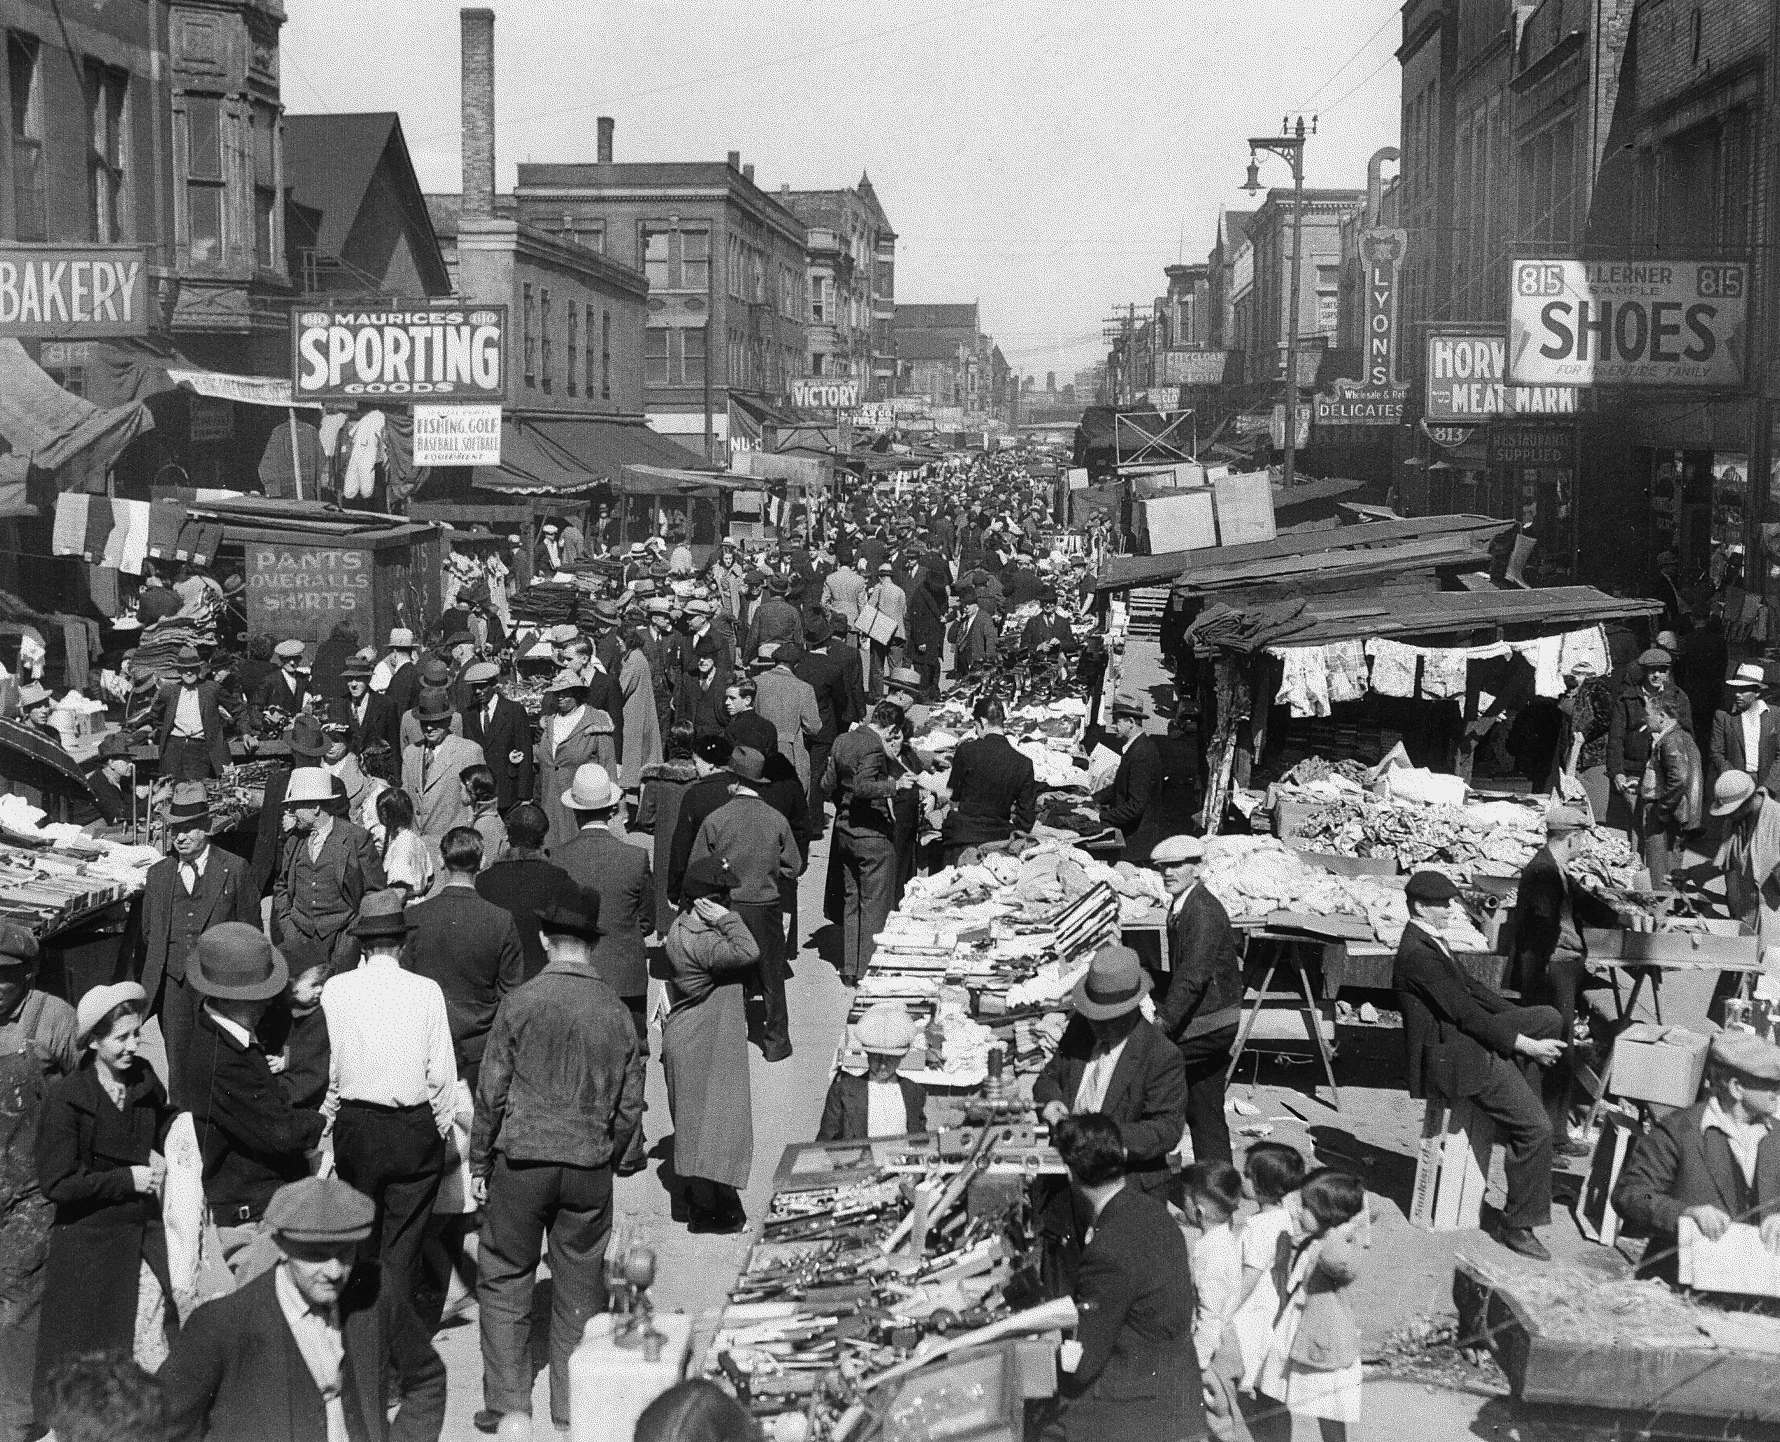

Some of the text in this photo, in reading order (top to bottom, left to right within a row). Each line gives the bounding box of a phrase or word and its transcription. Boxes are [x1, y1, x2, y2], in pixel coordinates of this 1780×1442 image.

[1521, 266, 1561, 294] 815
[1596, 267, 1672, 284] LERNER
[1700, 269, 1740, 296] 815
[1589, 285, 1661, 296] SAMPLE
[0, 261, 139, 322] BAKERY
[1540, 301, 1718, 362] SHOES
[299, 326, 501, 390] SPORTING
[1666, 366, 1712, 377] FAMILY
[344, 383, 454, 394] GOODS
[792, 384, 858, 406] VICTORY
[1452, 383, 1504, 413] MEAT
[468, 417, 499, 434] GOLF
[1435, 427, 1463, 442] 813
[1496, 448, 1562, 462] SUPPLIED
[257, 551, 362, 570] PANTS
[250, 573, 370, 589] OVERALLS
[263, 592, 356, 611] SHIRTS
